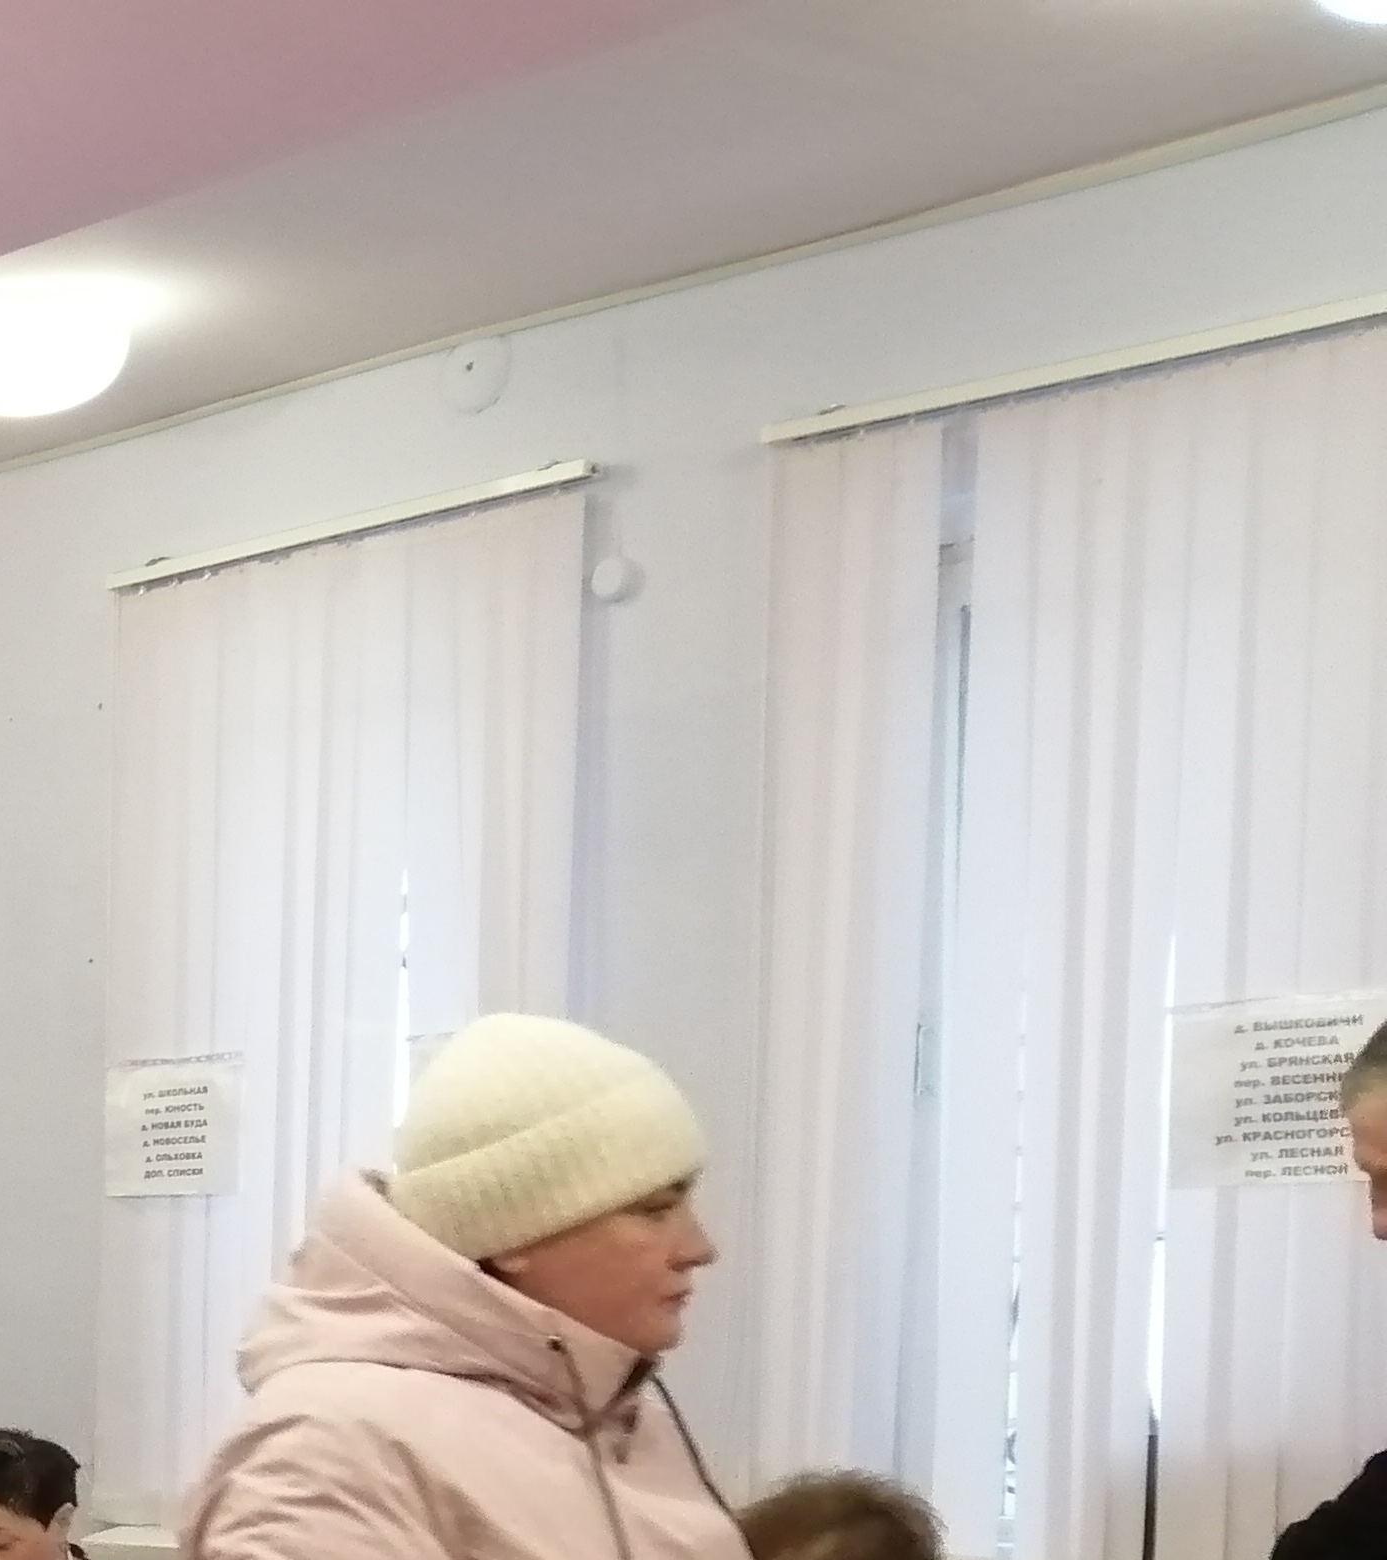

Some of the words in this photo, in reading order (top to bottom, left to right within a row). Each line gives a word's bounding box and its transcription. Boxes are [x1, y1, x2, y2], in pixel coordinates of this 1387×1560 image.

[1252, 1014, 1364, 1031] ВЫШКОВИЧИ
[1273, 1035, 1339, 1049] КОЧЕВА
[1267, 1052, 1354, 1068] БРЯНСКАЯ
[1270, 1072, 1342, 1086] ВЕСЕНН
[158, 1086, 208, 1098] ШКОЛЬНАЯ
[1263, 1091, 1340, 1105] ЗАБОРСК
[165, 1103, 204, 1114] ЮНОСТЬ
[1262, 1109, 1345, 1123] КОЛЬЦЕВ
[151, 1121, 182, 1131] НОВАЯ
[184, 1119, 208, 1129] БУДА
[1242, 1127, 1351, 1142] КРАСНОГОРС
[153, 1136, 206, 1147] НОВОСЕЛЬЕ
[155, 1152, 203, 1162] ОЛЬХОВКА
[1277, 1146, 1344, 1159] ЛЕСНАЯ
[144, 1170, 164, 1179] ДОП.
[167, 1168, 204, 1178] СПИСКИ
[1281, 1163, 1348, 1176] ЛЕСНОЙ
